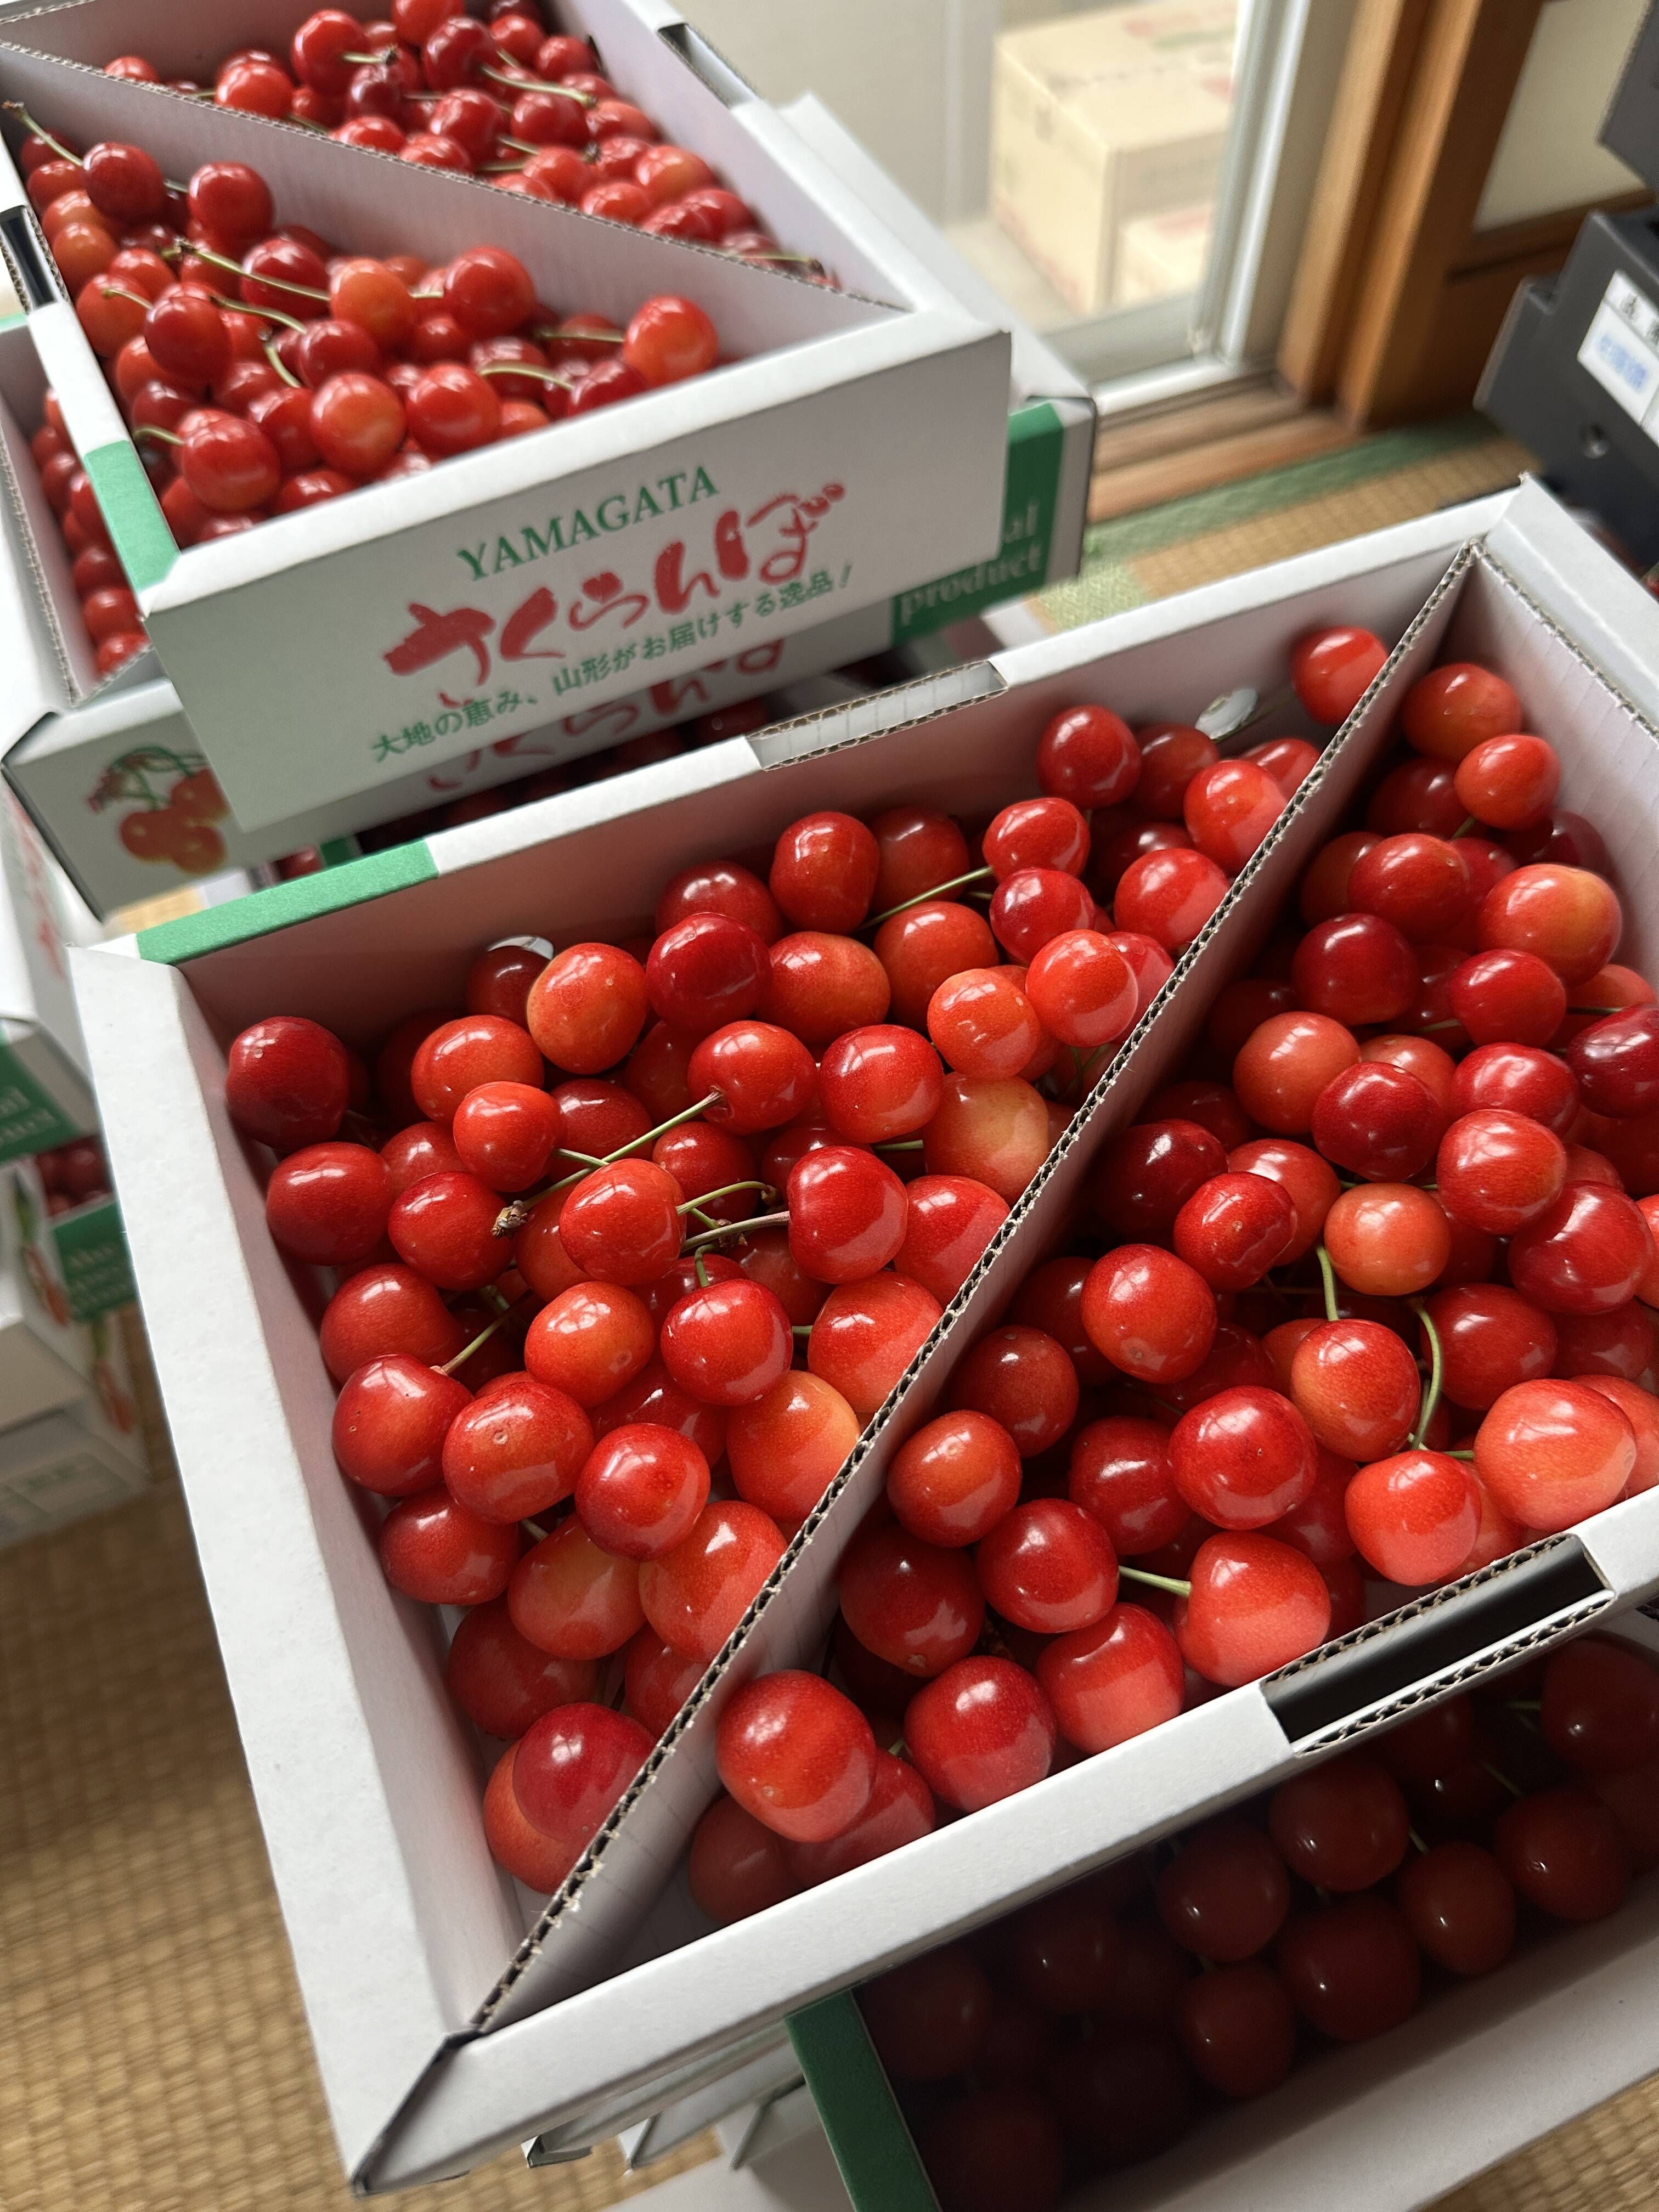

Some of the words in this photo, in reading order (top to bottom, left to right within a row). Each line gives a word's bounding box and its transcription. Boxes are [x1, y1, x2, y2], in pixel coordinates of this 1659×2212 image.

[457, 466, 720, 582] YAMAGATA
[383, 483, 846, 710] さくらんぼ
[900, 542, 1043, 628] product
